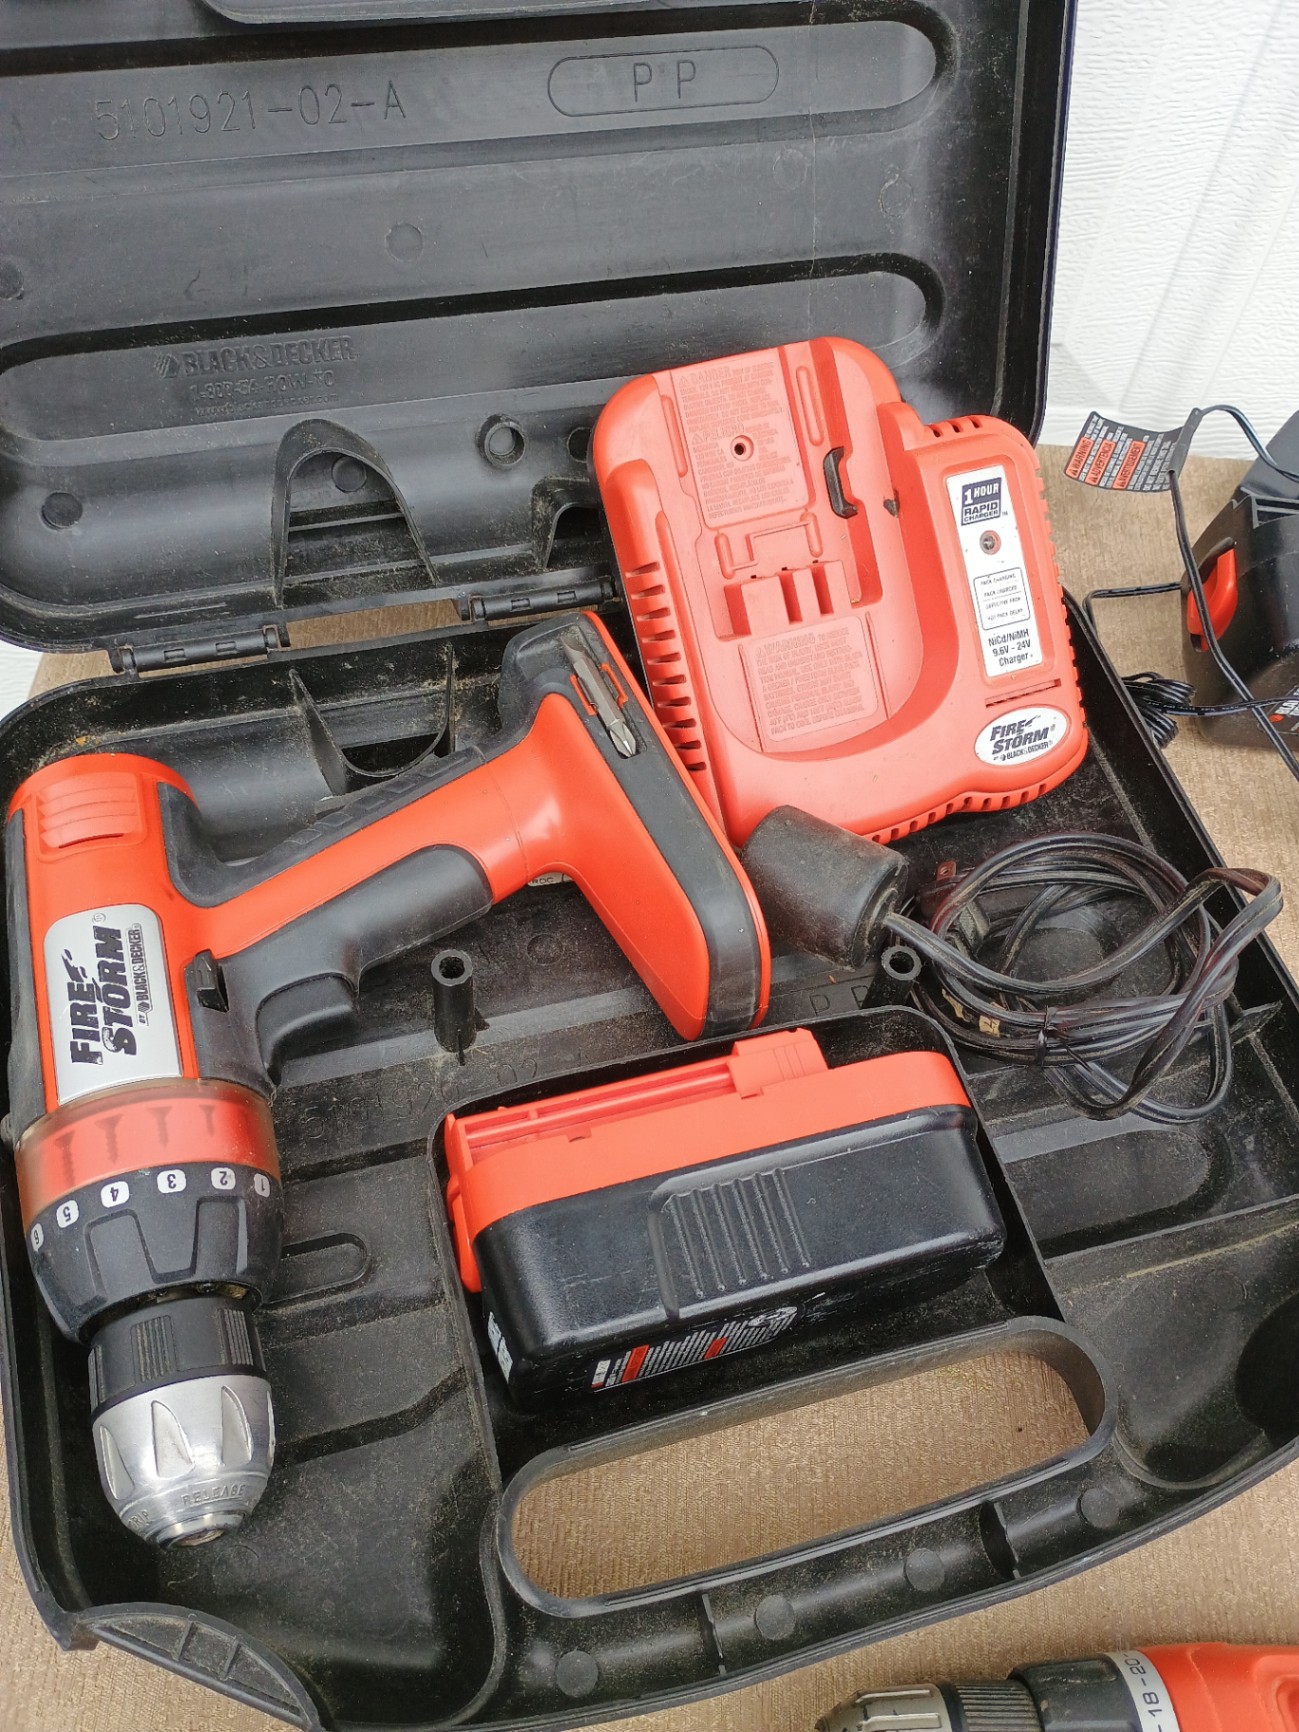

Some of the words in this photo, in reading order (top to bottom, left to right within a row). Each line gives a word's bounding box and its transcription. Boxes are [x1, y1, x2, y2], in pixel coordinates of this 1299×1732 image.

[1075, 438, 1092, 470] WARNING
[1092, 442, 1114, 476] ADVERTENCIA
[964, 488, 974, 505] 1
[973, 483, 999, 498] HOUR
[964, 501, 998, 516] RAPID
[964, 509, 999, 522] CHARGER
[988, 628, 1029, 646] NiCd/NiMH
[992, 645, 1009, 657] 9.6V
[1017, 639, 1031, 651] 24V
[998, 652, 1029, 667] Charger
[990, 719, 1027, 741] FIRE
[992, 727, 1050, 755] STORM
[1006, 742, 1049, 760] BLACK&DECKER
[128, 928, 149, 1002] BLACK&DECKER
[93, 925, 137, 1056] STORM
[67, 981, 103, 1065] FIRE
[166, 1173, 177, 1189] 3
[219, 1170, 229, 1186] 2
[110, 1186, 120, 1202] 4
[62, 1206, 72, 1222] 5
[182, 1484, 246, 1505] RELEASE
